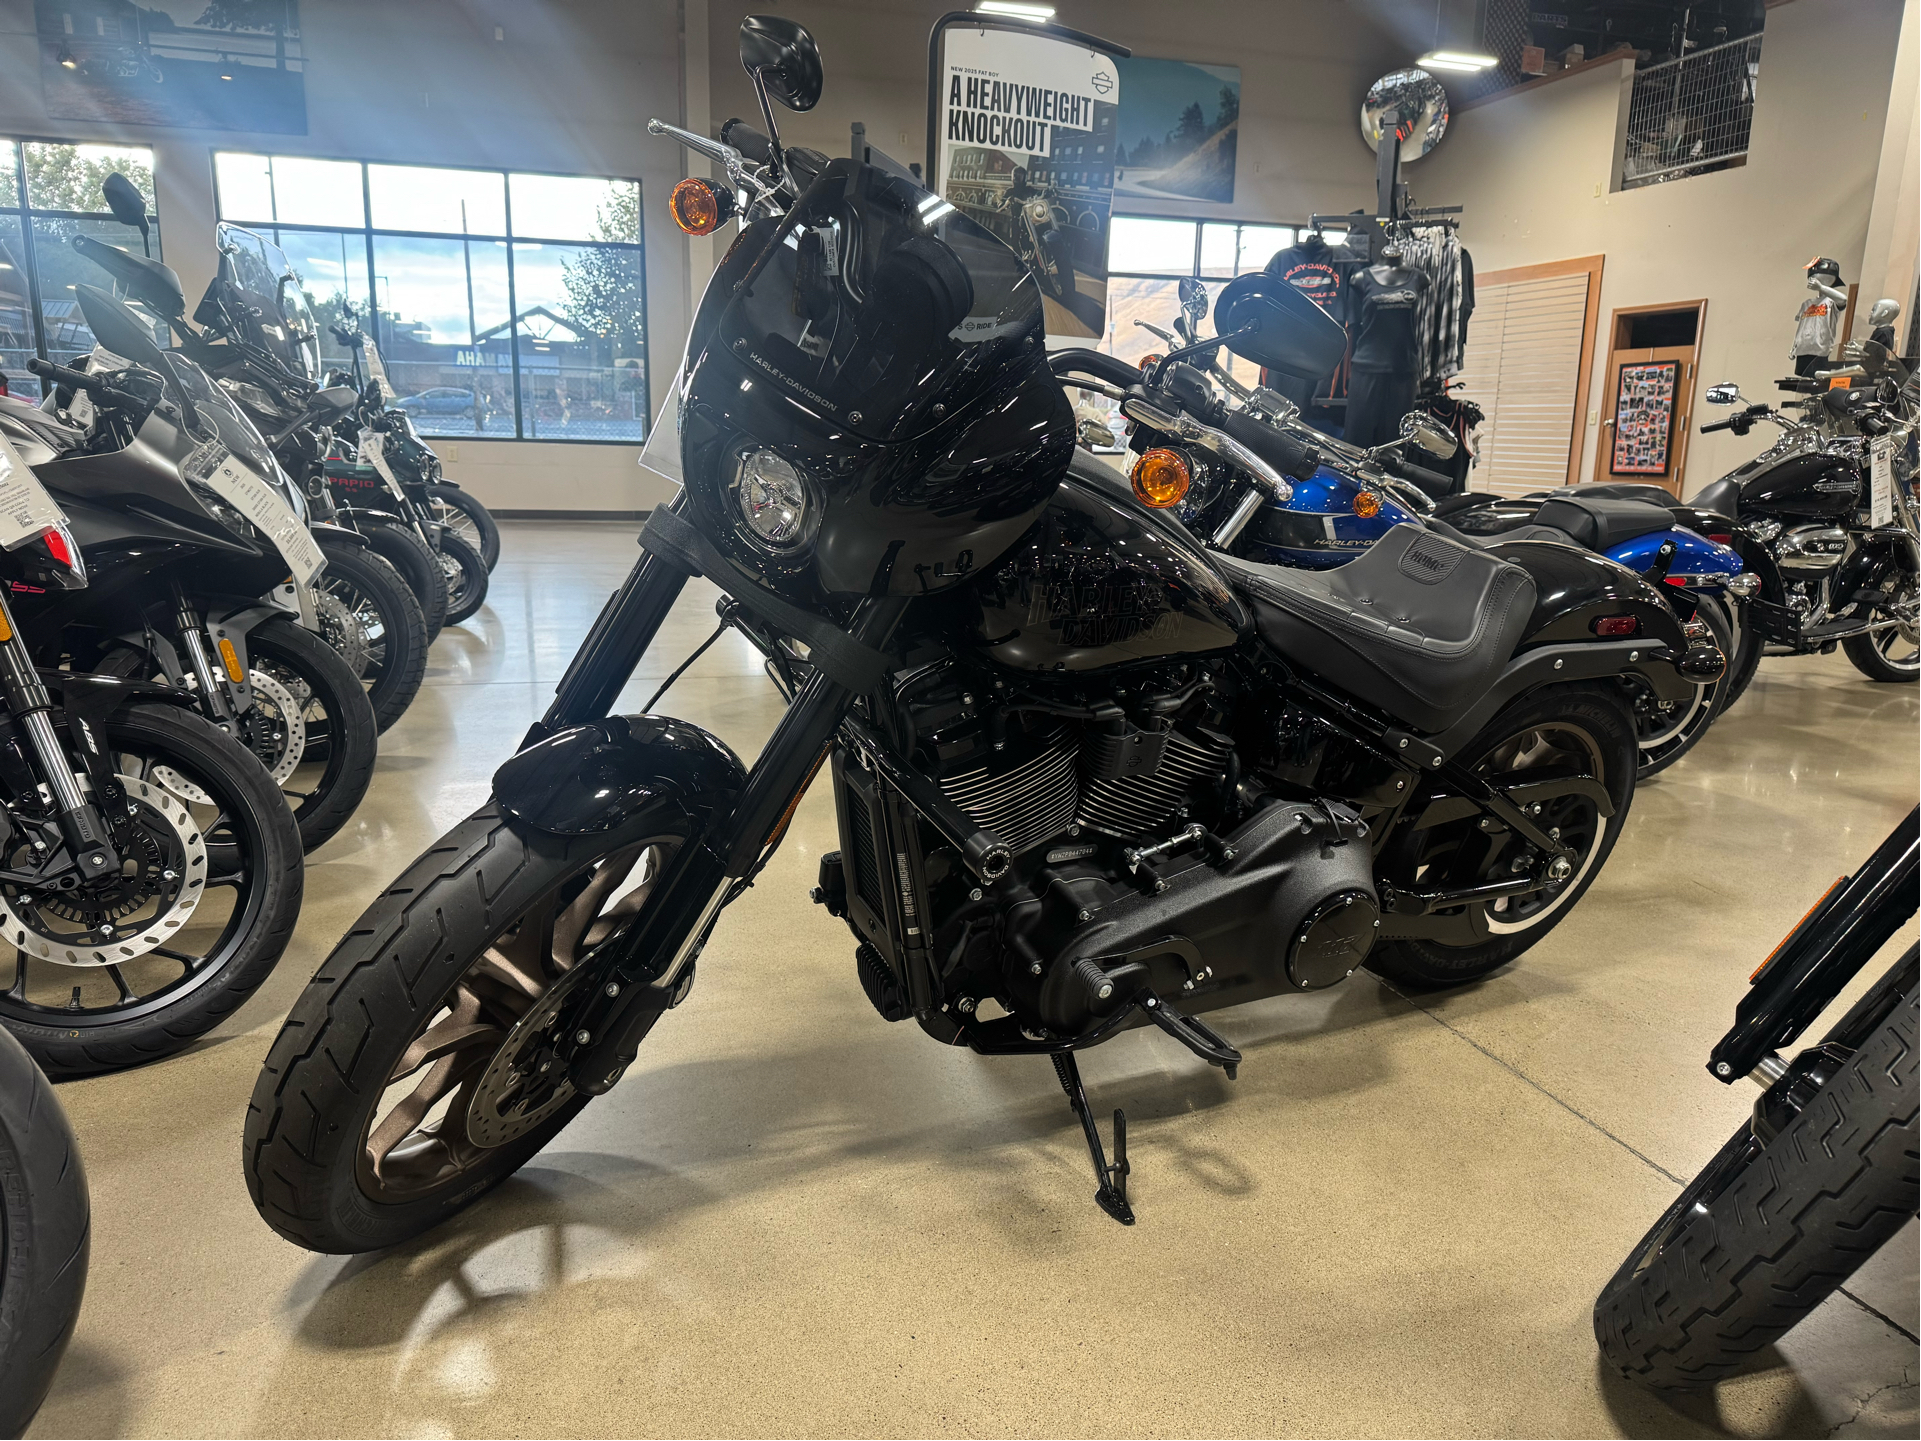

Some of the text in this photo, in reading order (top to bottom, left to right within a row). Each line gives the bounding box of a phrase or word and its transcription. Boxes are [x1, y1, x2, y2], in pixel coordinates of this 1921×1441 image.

[950, 65, 964, 73] NEW
[949, 74, 1092, 127] A HEAVYWEIGHT
[948, 108, 1048, 153] KNOCKOUT
[976, 322, 993, 330] RIDE
[749, 351, 838, 412] HARLEY-DAVIDSON
[329, 476, 374, 488] PAPIO
[1057, 611, 1184, 646] DAVIDSON
[78, 717, 100, 756] ABS
[982, 848, 1011, 879] HARLEY DAVIDSON
